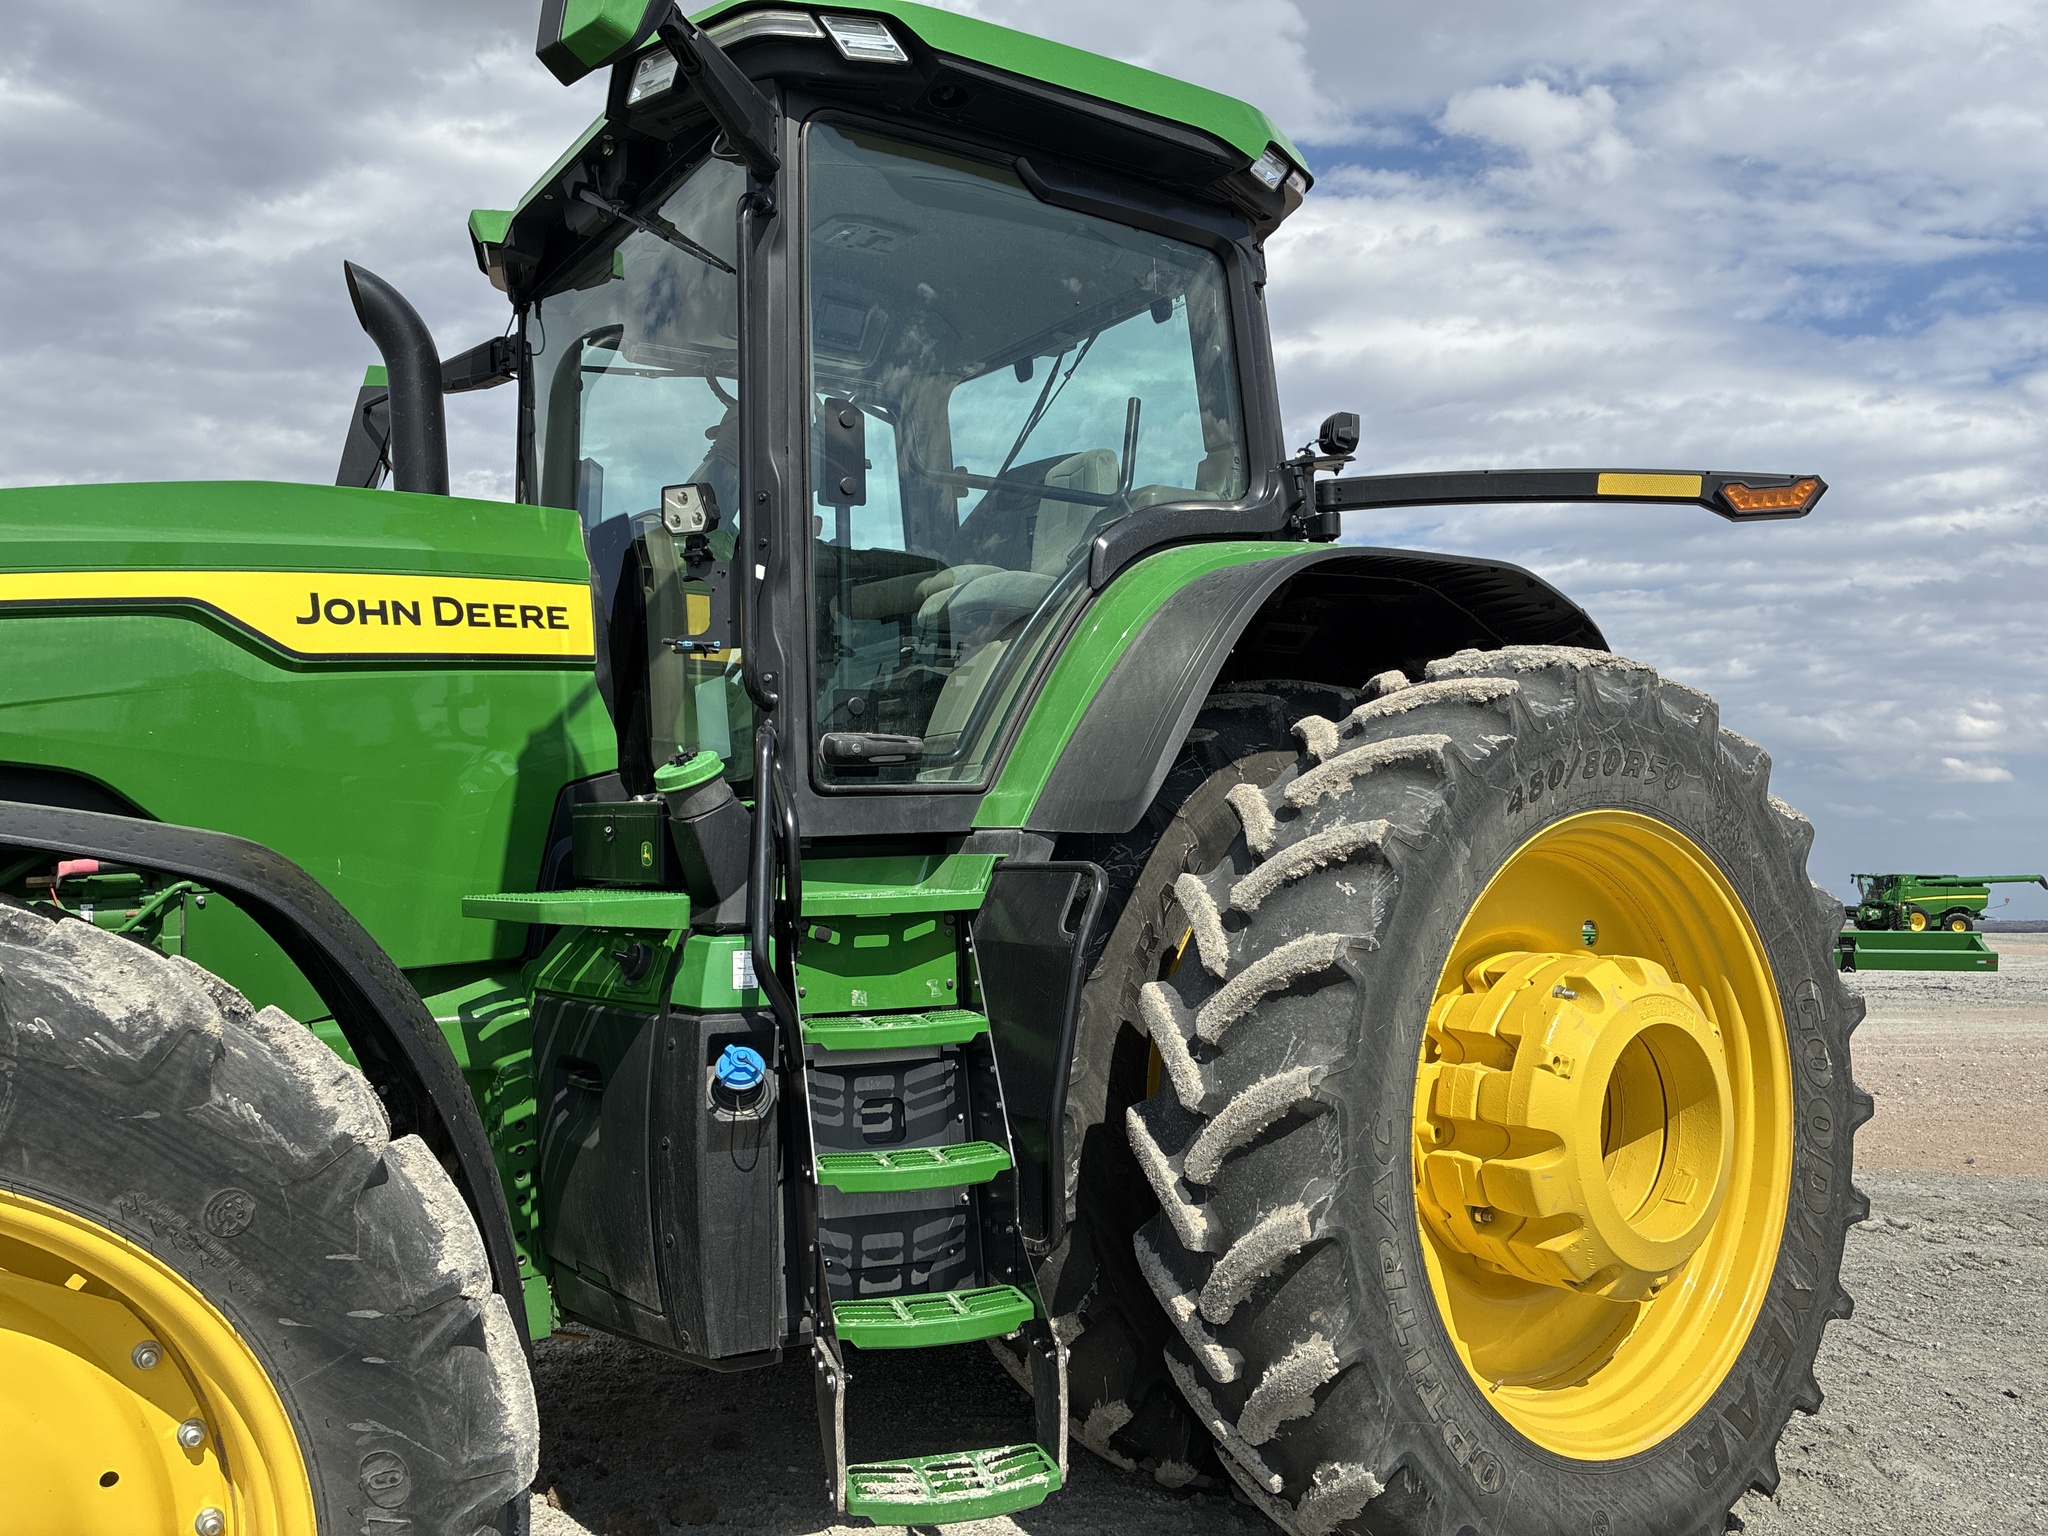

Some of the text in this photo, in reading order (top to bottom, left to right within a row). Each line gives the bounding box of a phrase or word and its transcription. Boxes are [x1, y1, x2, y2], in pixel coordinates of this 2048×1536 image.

[296, 592, 570, 630] JOHN DEERE
[136, 1192, 265, 1293] RADIAL TUBELESS
[1371, 1110, 1507, 1494] OPTITRAC
